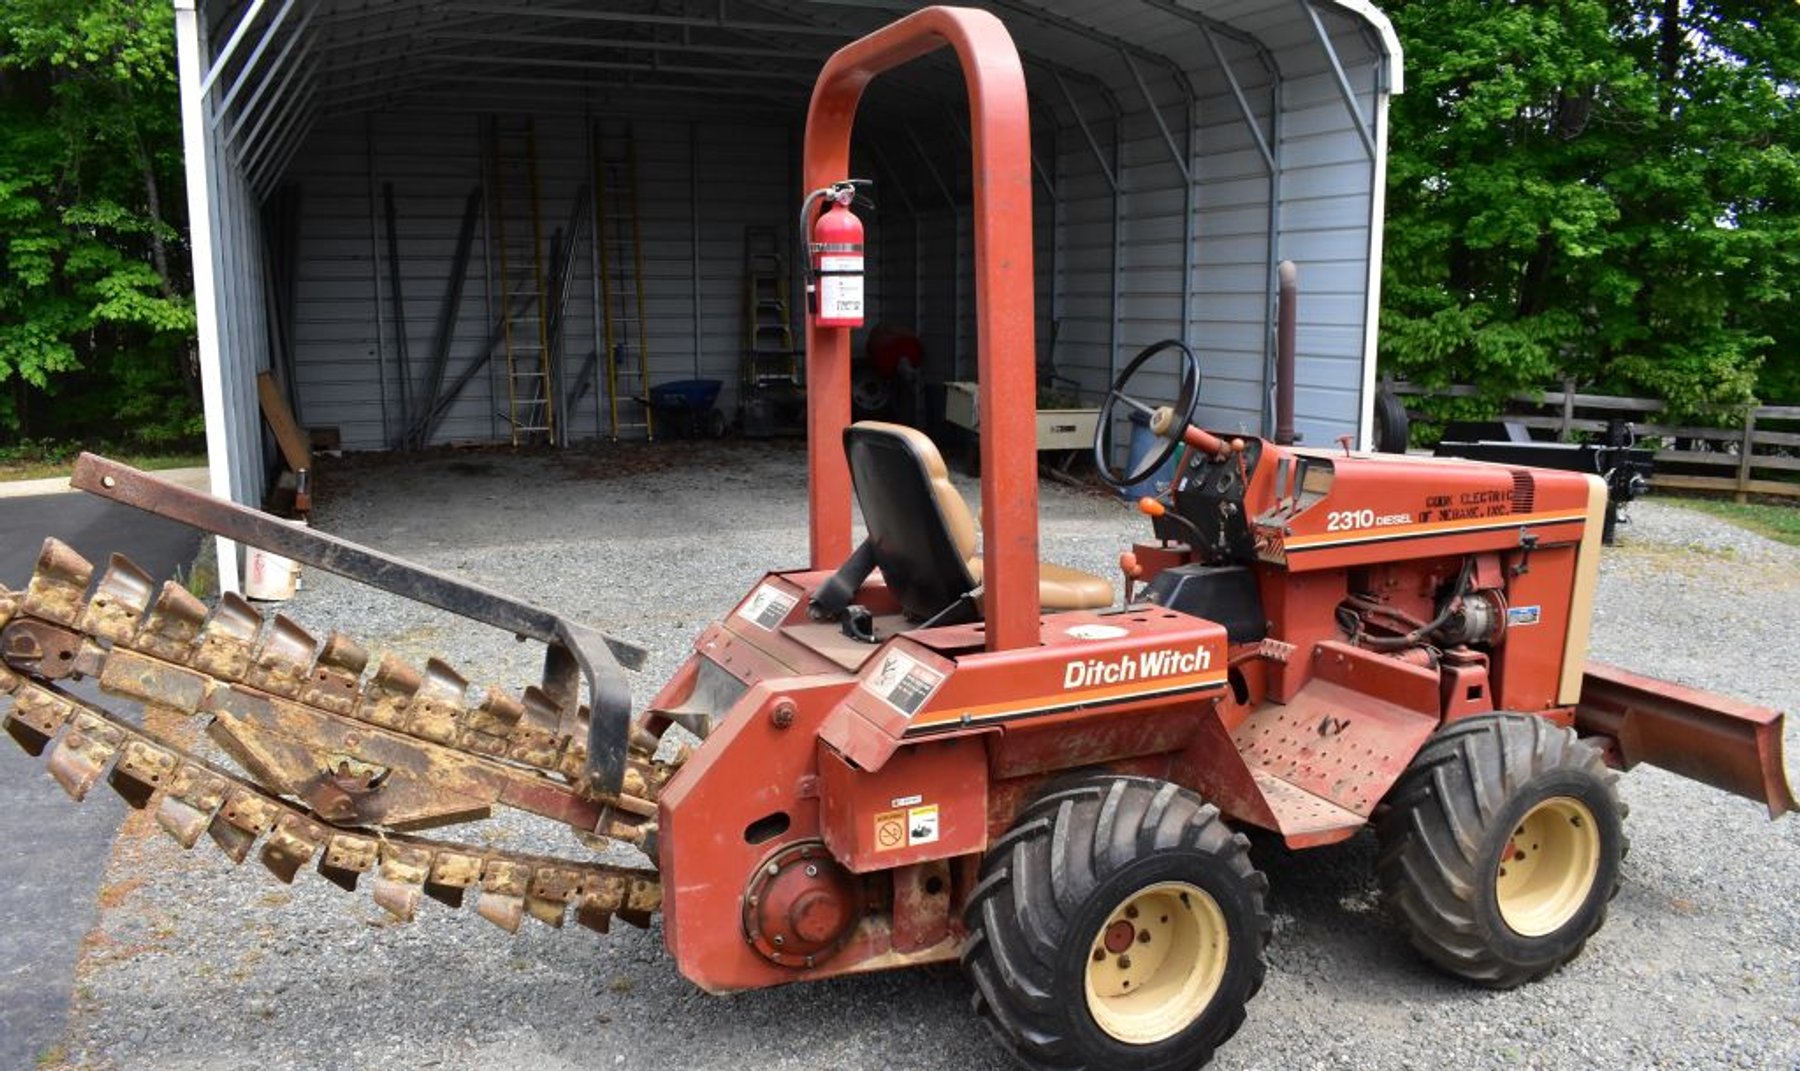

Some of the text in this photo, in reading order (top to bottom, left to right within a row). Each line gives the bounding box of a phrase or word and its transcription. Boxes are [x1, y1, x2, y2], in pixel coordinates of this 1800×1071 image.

[1327, 509, 1413, 531] 2310 DIESEL
[1063, 645, 1211, 689] Ditch Witch
